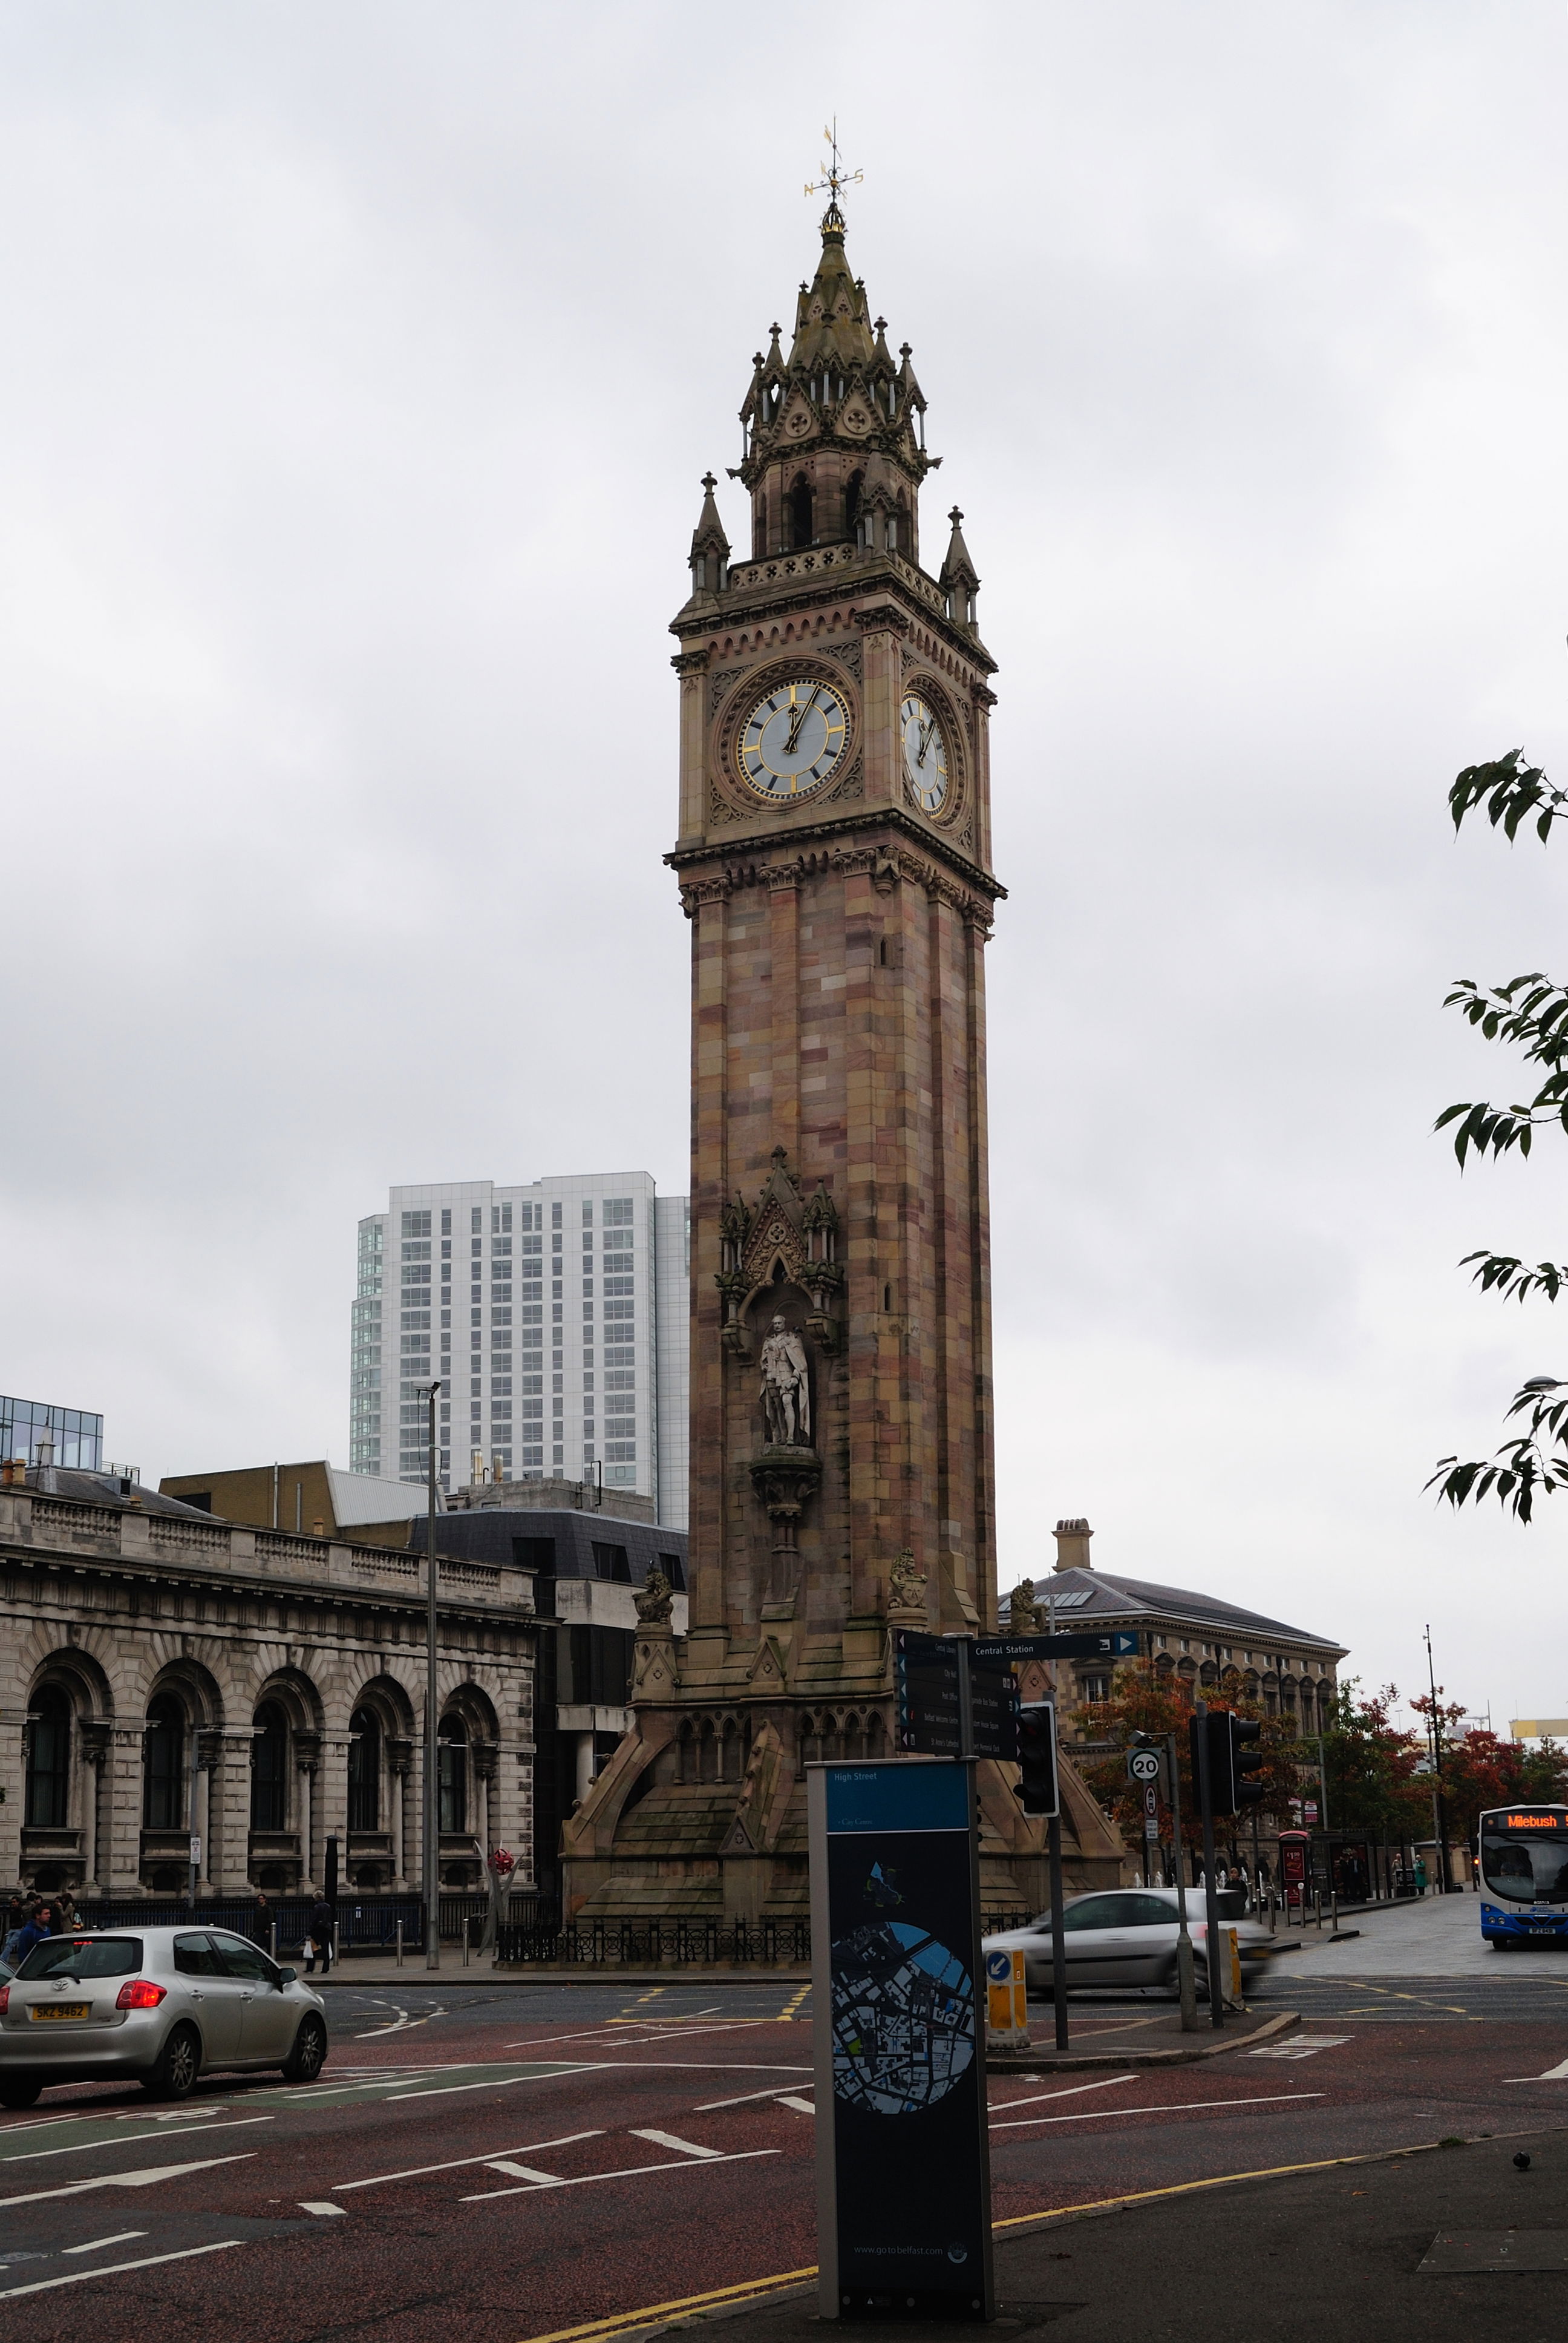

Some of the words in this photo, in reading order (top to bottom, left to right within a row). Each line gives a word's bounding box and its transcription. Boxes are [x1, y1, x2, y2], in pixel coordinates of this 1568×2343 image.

[935, 1642, 946, 1653] Central
[946, 1645, 956, 1656] Library
[975, 1646, 1003, 1656] Central
[1005, 1644, 1034, 1654] Station
[949, 1692, 958, 1702] Office
[988, 1699, 998, 1708] Station
[924, 1712, 935, 1722] Belfast
[935, 1714, 949, 1724] Welcome
[949, 1715, 958, 1725] Centre
[981, 1720, 989, 1729] House
[989, 1721, 999, 1730] Square
[979, 1743, 992, 1752] Memorial
[1135, 1760, 1157, 1773] 20
[834, 1772, 852, 1783] High
[854, 1772, 877, 1781] Street
[1508, 1815, 1557, 1827] Milebush
[37, 2007, 55, 2017] SKZ
[57, 2005, 83, 2017] 9462
